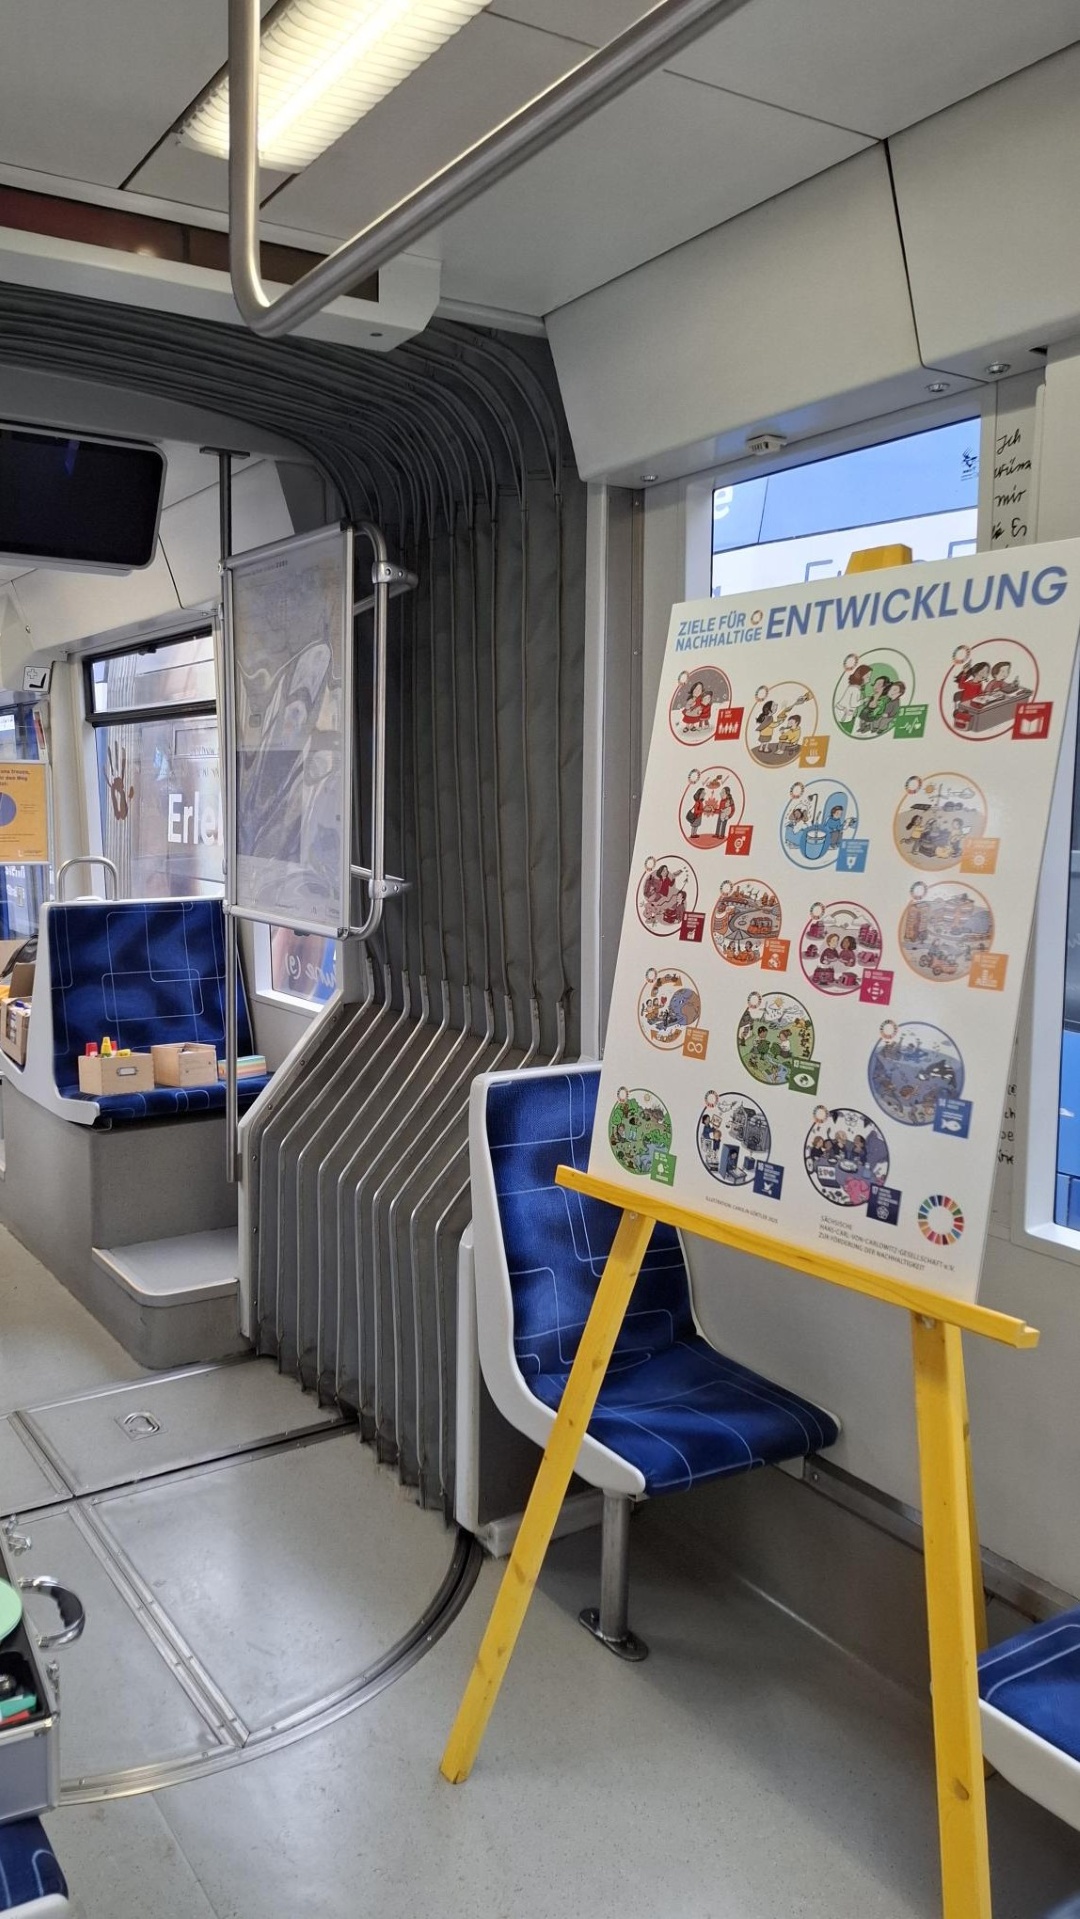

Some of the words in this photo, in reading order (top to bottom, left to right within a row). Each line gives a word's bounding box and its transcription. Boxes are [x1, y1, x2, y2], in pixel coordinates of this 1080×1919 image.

[766, 566, 1068, 639] ENTWICKLUNG
[678, 617, 716, 636] ZIELE
[718, 610, 746, 629] FÜR
[675, 627, 763, 651] NACHHALTIGE
